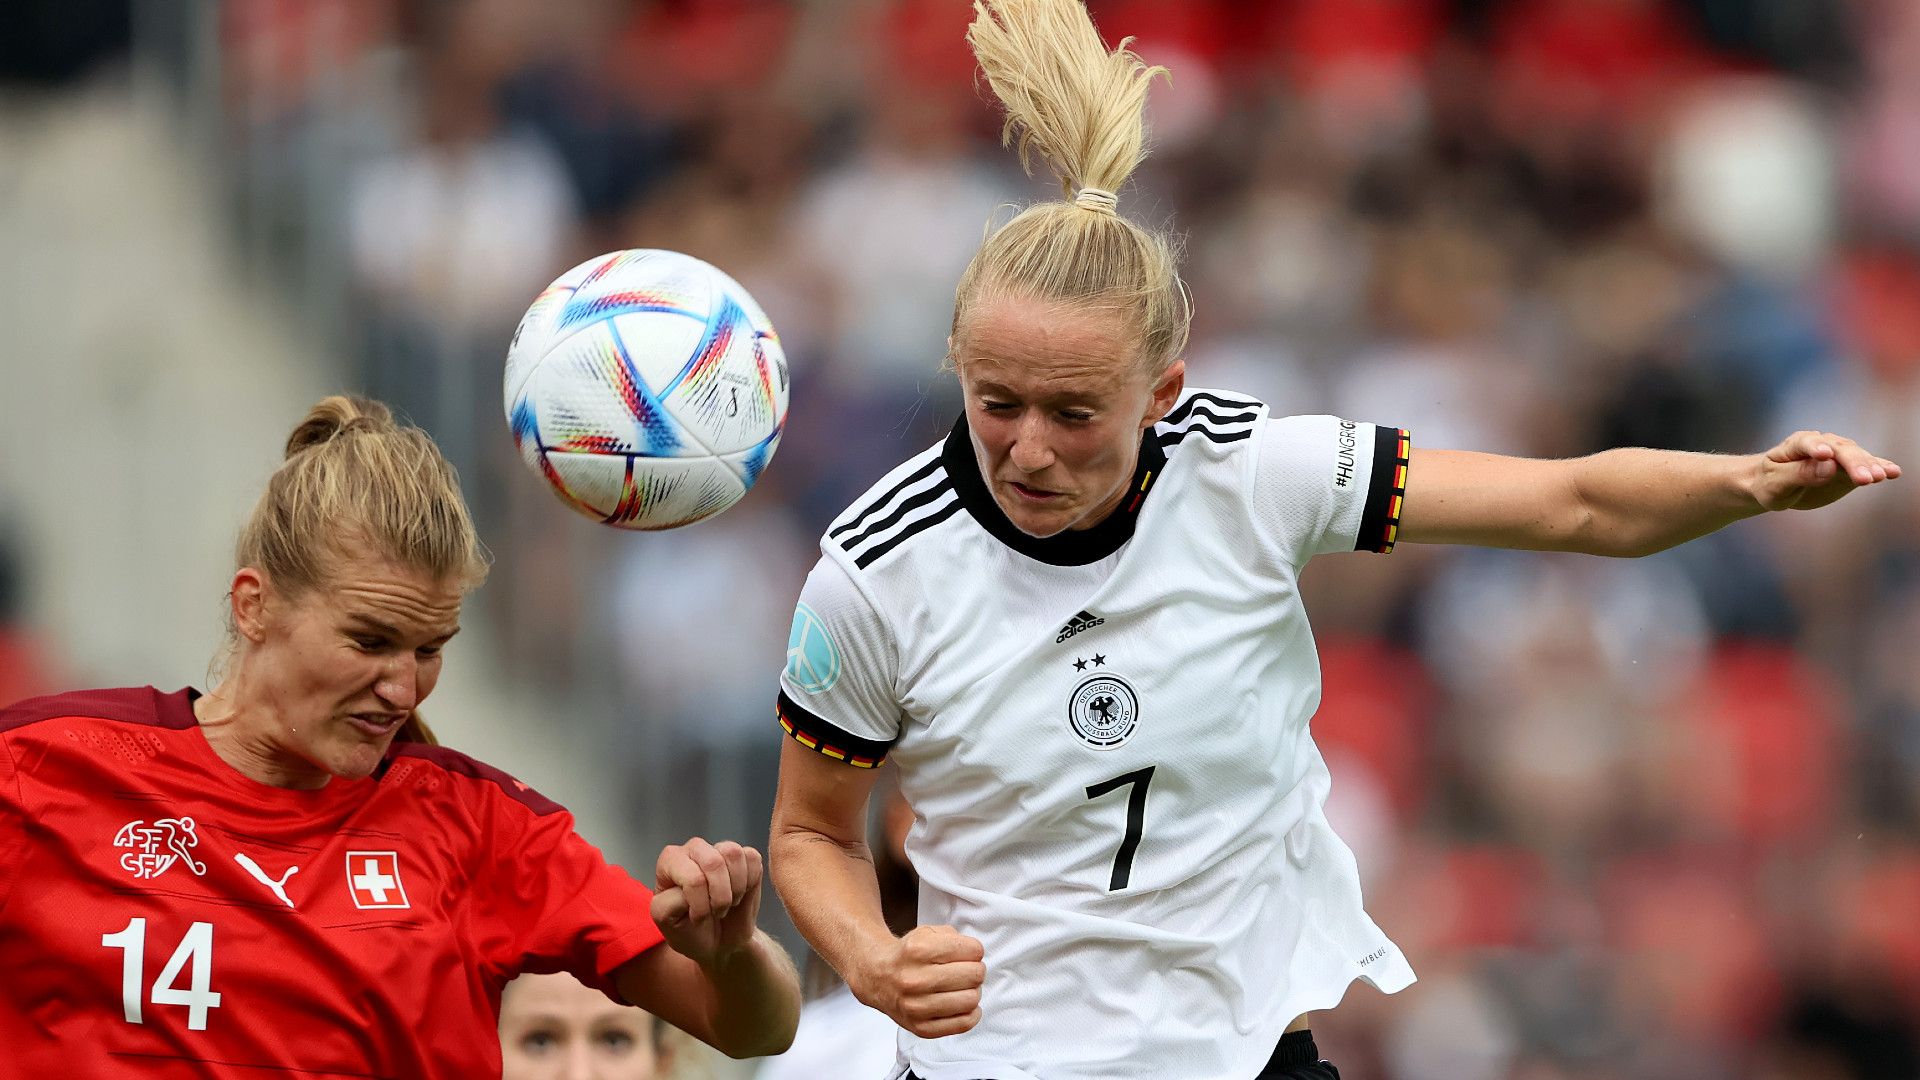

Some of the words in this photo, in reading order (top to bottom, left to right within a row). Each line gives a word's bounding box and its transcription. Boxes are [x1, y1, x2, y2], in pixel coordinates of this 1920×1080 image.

[1055, 617, 1106, 644] adidas
[1079, 685, 1118, 704] DEUTSCHER
[1084, 710, 1130, 737] FUSSBALL-BUND
[1085, 765, 1156, 891] 7
[101, 917, 221, 1030] 14
